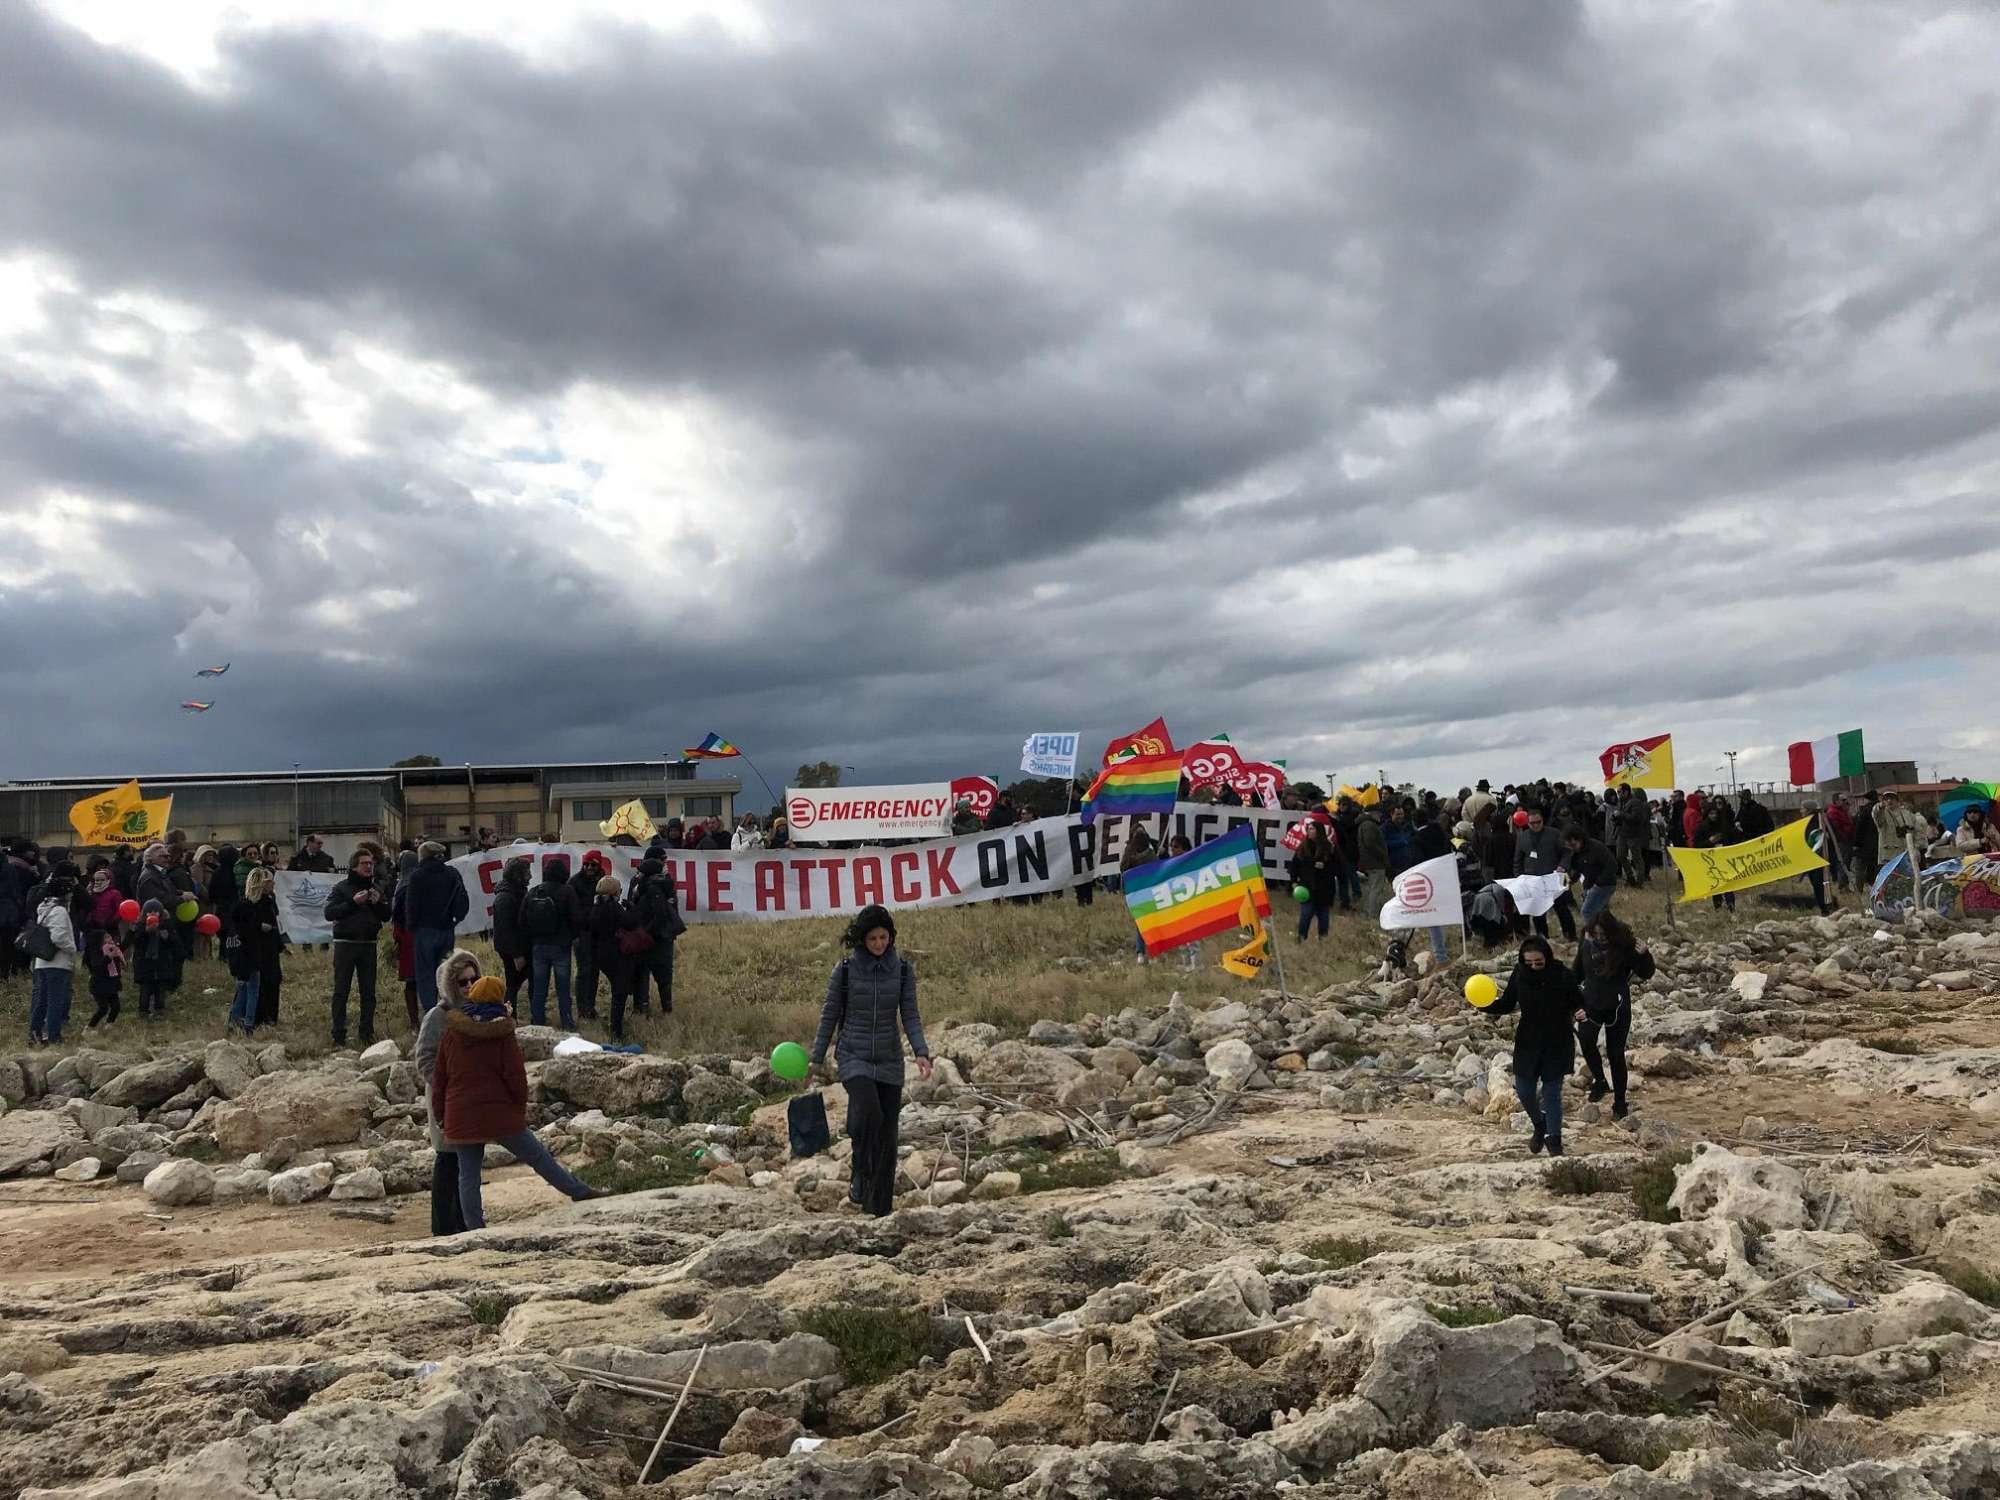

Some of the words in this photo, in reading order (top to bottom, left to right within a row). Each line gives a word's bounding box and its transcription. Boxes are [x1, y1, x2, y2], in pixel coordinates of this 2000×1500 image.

[819, 799, 948, 821] EMERGENCY
[754, 846, 962, 912] ATTACK
[976, 829, 1049, 890] ON
